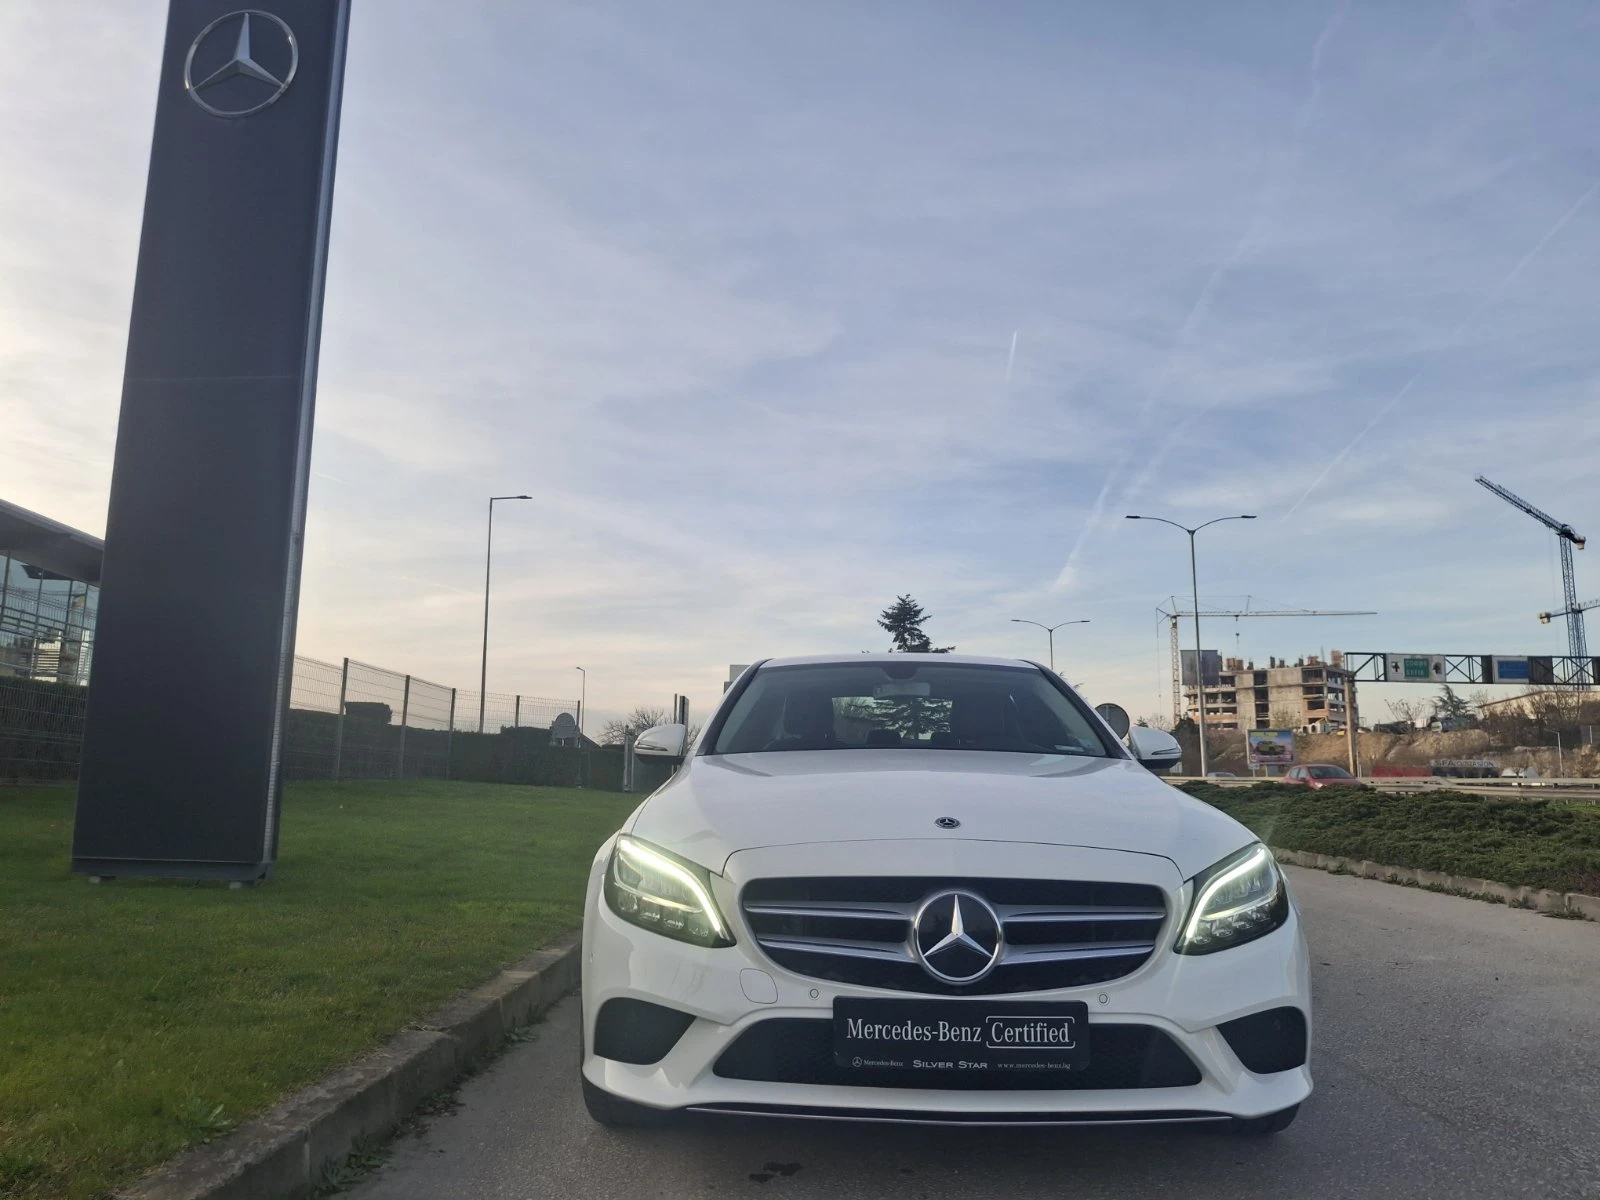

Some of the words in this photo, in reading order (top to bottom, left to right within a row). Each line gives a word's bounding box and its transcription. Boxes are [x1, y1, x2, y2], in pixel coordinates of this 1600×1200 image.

[846, 1017, 983, 1043] Mercedes-Benz
[991, 1021, 1071, 1044] Certified
[863, 1059, 905, 1067] Mercedes-Benz
[912, 1059, 954, 1069] SILVER
[958, 1060, 988, 1069] STAR
[997, 1061, 1072, 1070] www.mercedes-benz.bg
